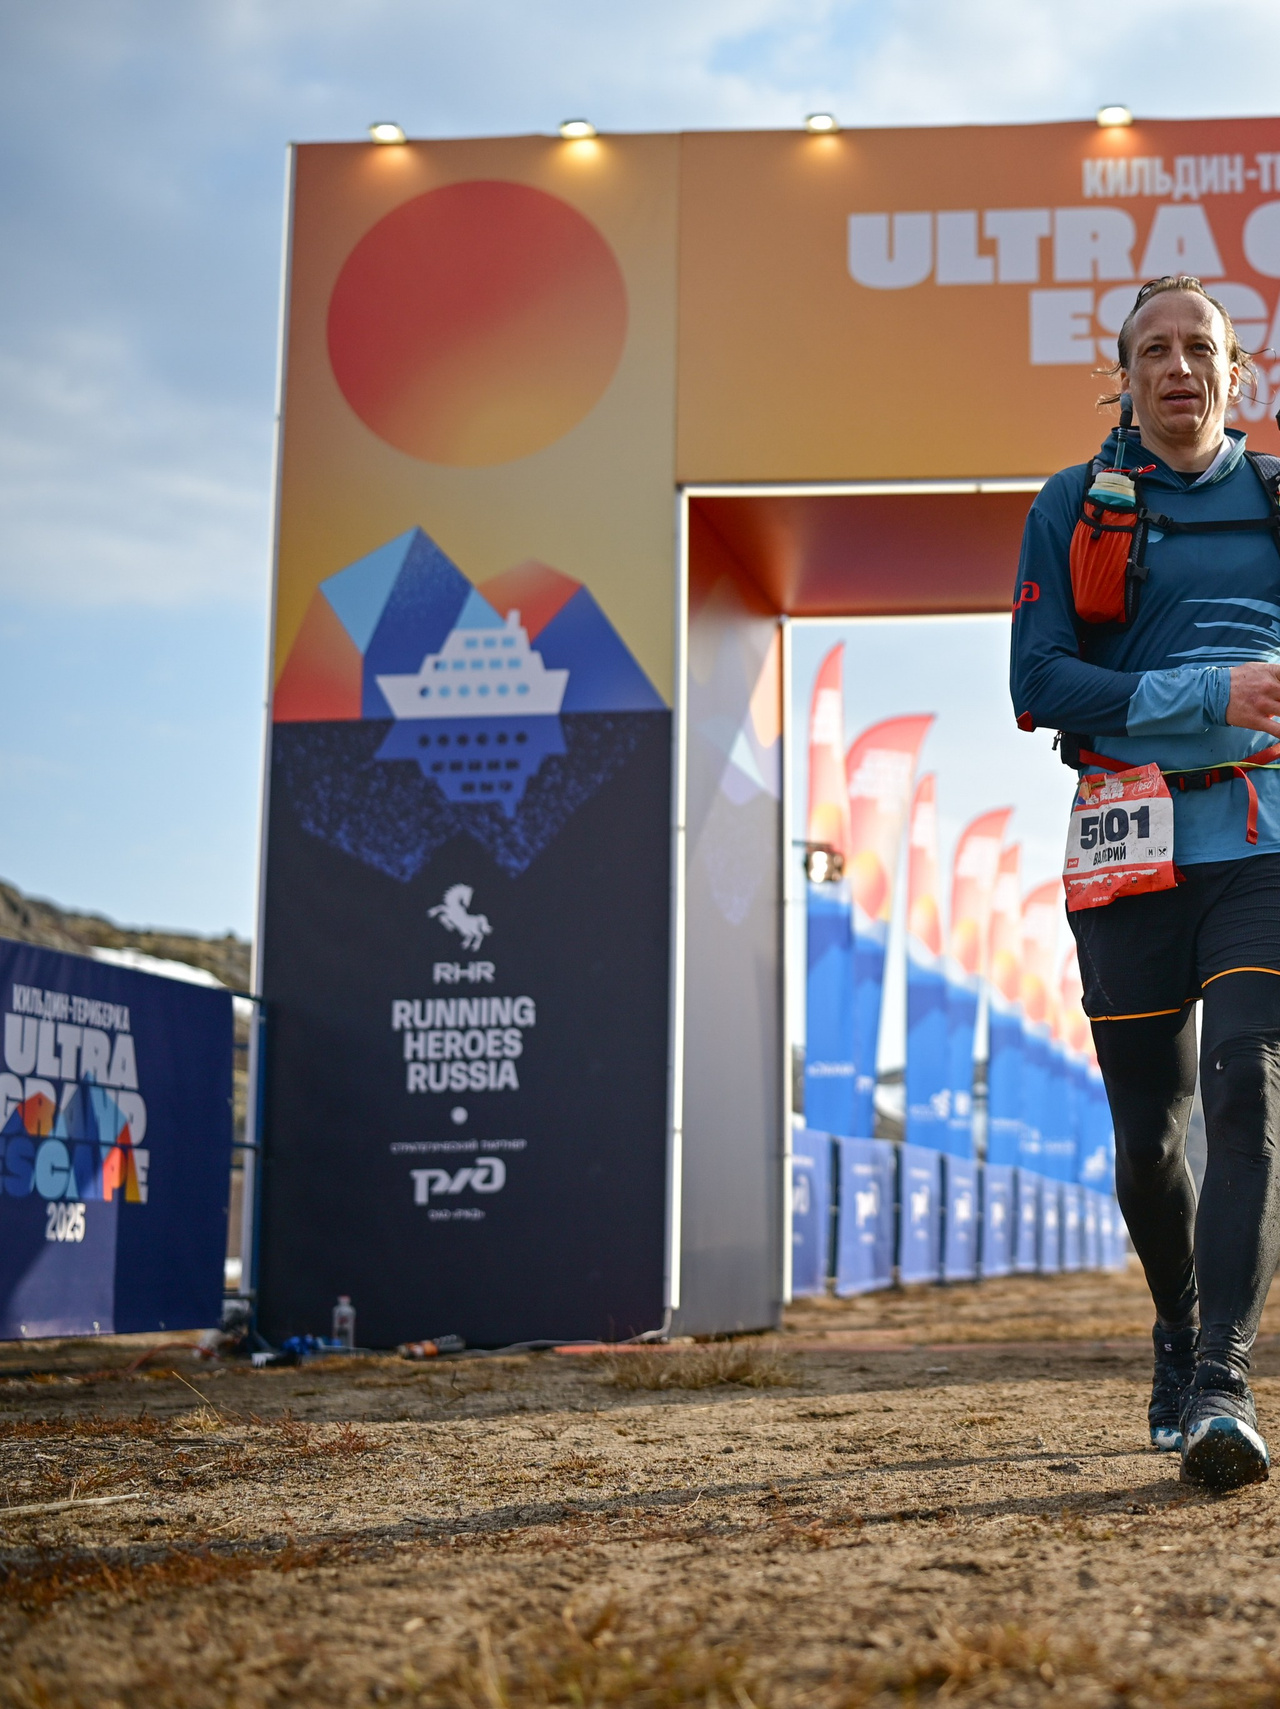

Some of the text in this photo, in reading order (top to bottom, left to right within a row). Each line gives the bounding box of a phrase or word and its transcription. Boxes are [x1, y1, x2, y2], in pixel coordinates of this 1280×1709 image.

[847, 203, 1225, 289] ULTRA
[433, 961, 496, 984] RHR
[12, 983, 131, 1033] КИЛЬДИН-ТЕРИБЕРКА
[392, 996, 536, 1031] RUNNING
[4, 1012, 139, 1091] ULTRA
[404, 1027, 523, 1062] HEROES
[407, 1059, 519, 1093] RUSSIA
[0, 1133, 150, 1205] SCAPE
[45, 1202, 87, 1243] 2025
